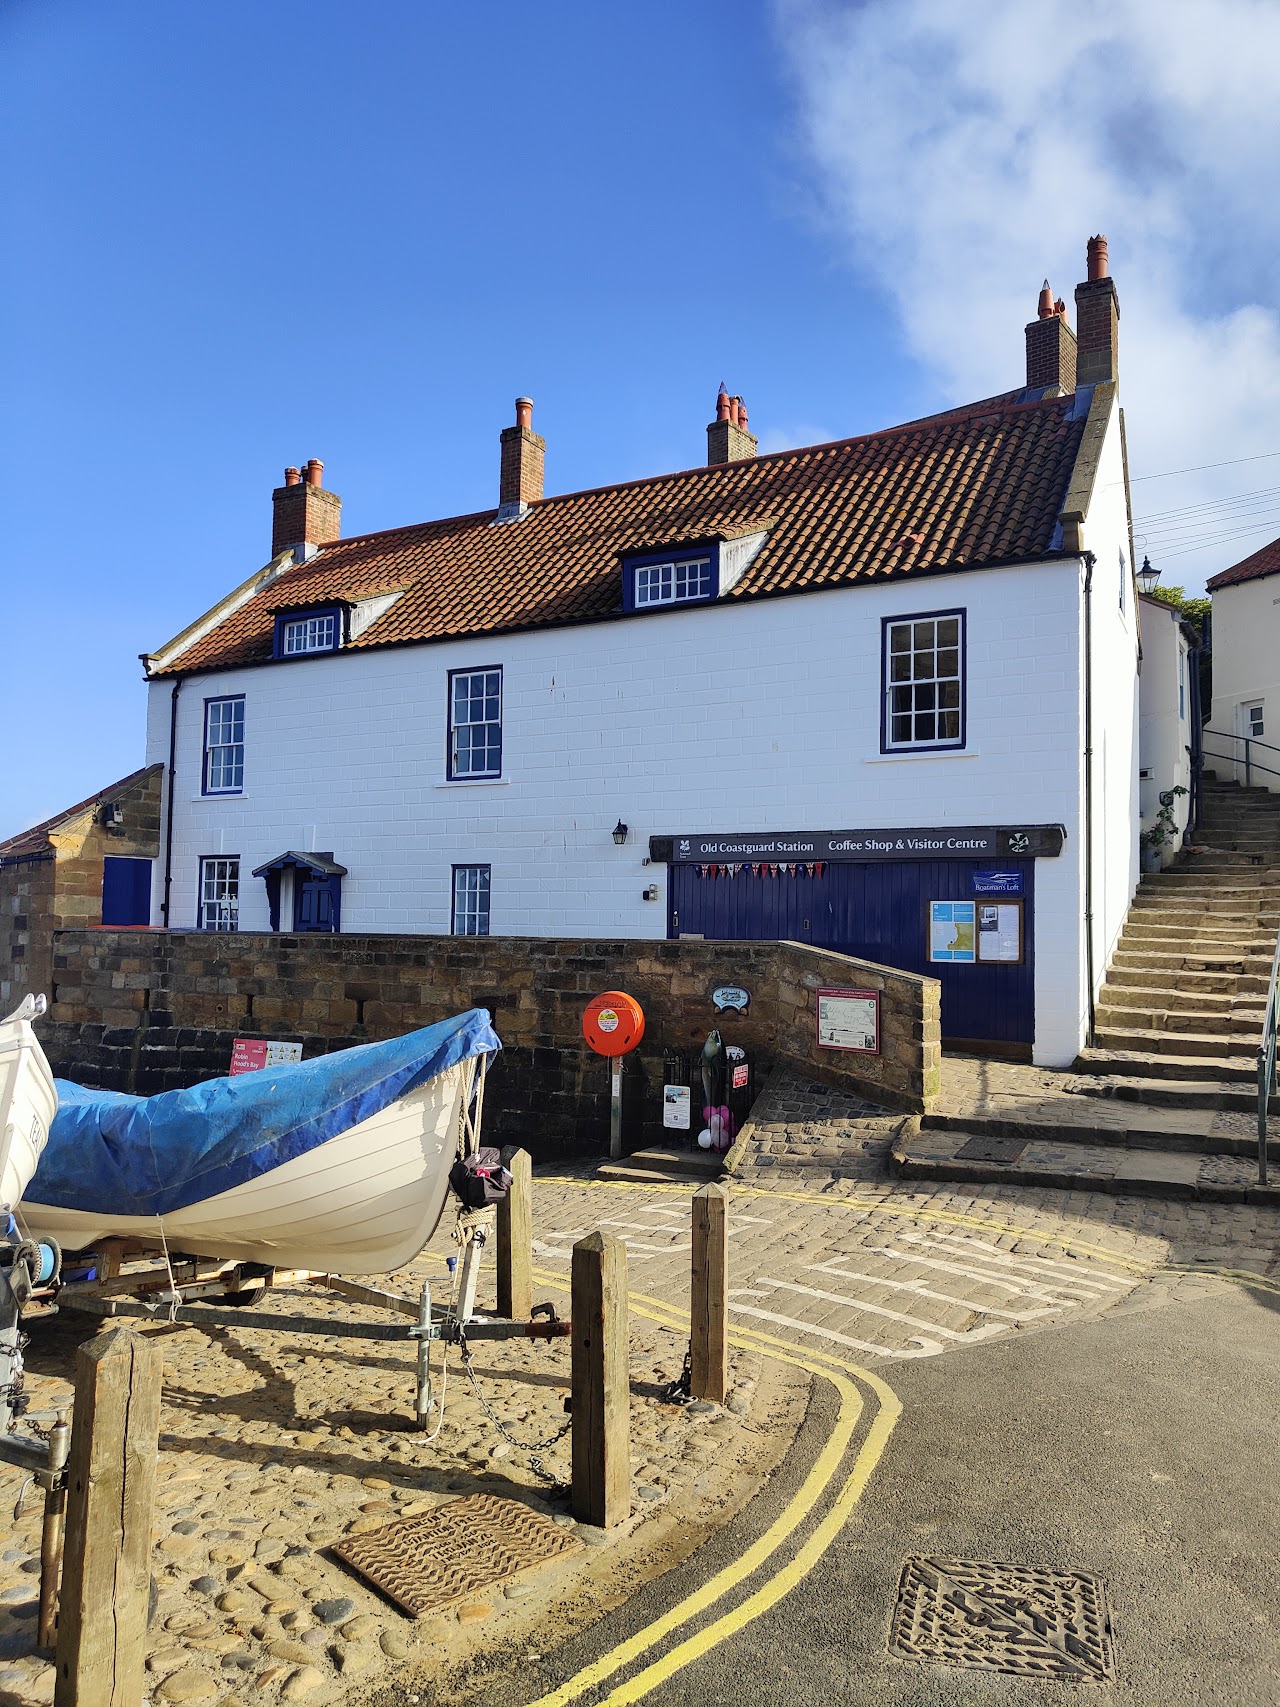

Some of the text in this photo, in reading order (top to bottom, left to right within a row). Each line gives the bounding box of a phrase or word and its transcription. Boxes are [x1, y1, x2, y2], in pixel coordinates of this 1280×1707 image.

[700, 841, 814, 854] Old Coastguard Station
[828, 837, 987, 852] Coffee Shop & Visitor Centre
[1006, 883, 1020, 891] Loft
[233, 1060, 259, 1069] Hood's Bay
[727, 1231, 1140, 1360] CLEAR
